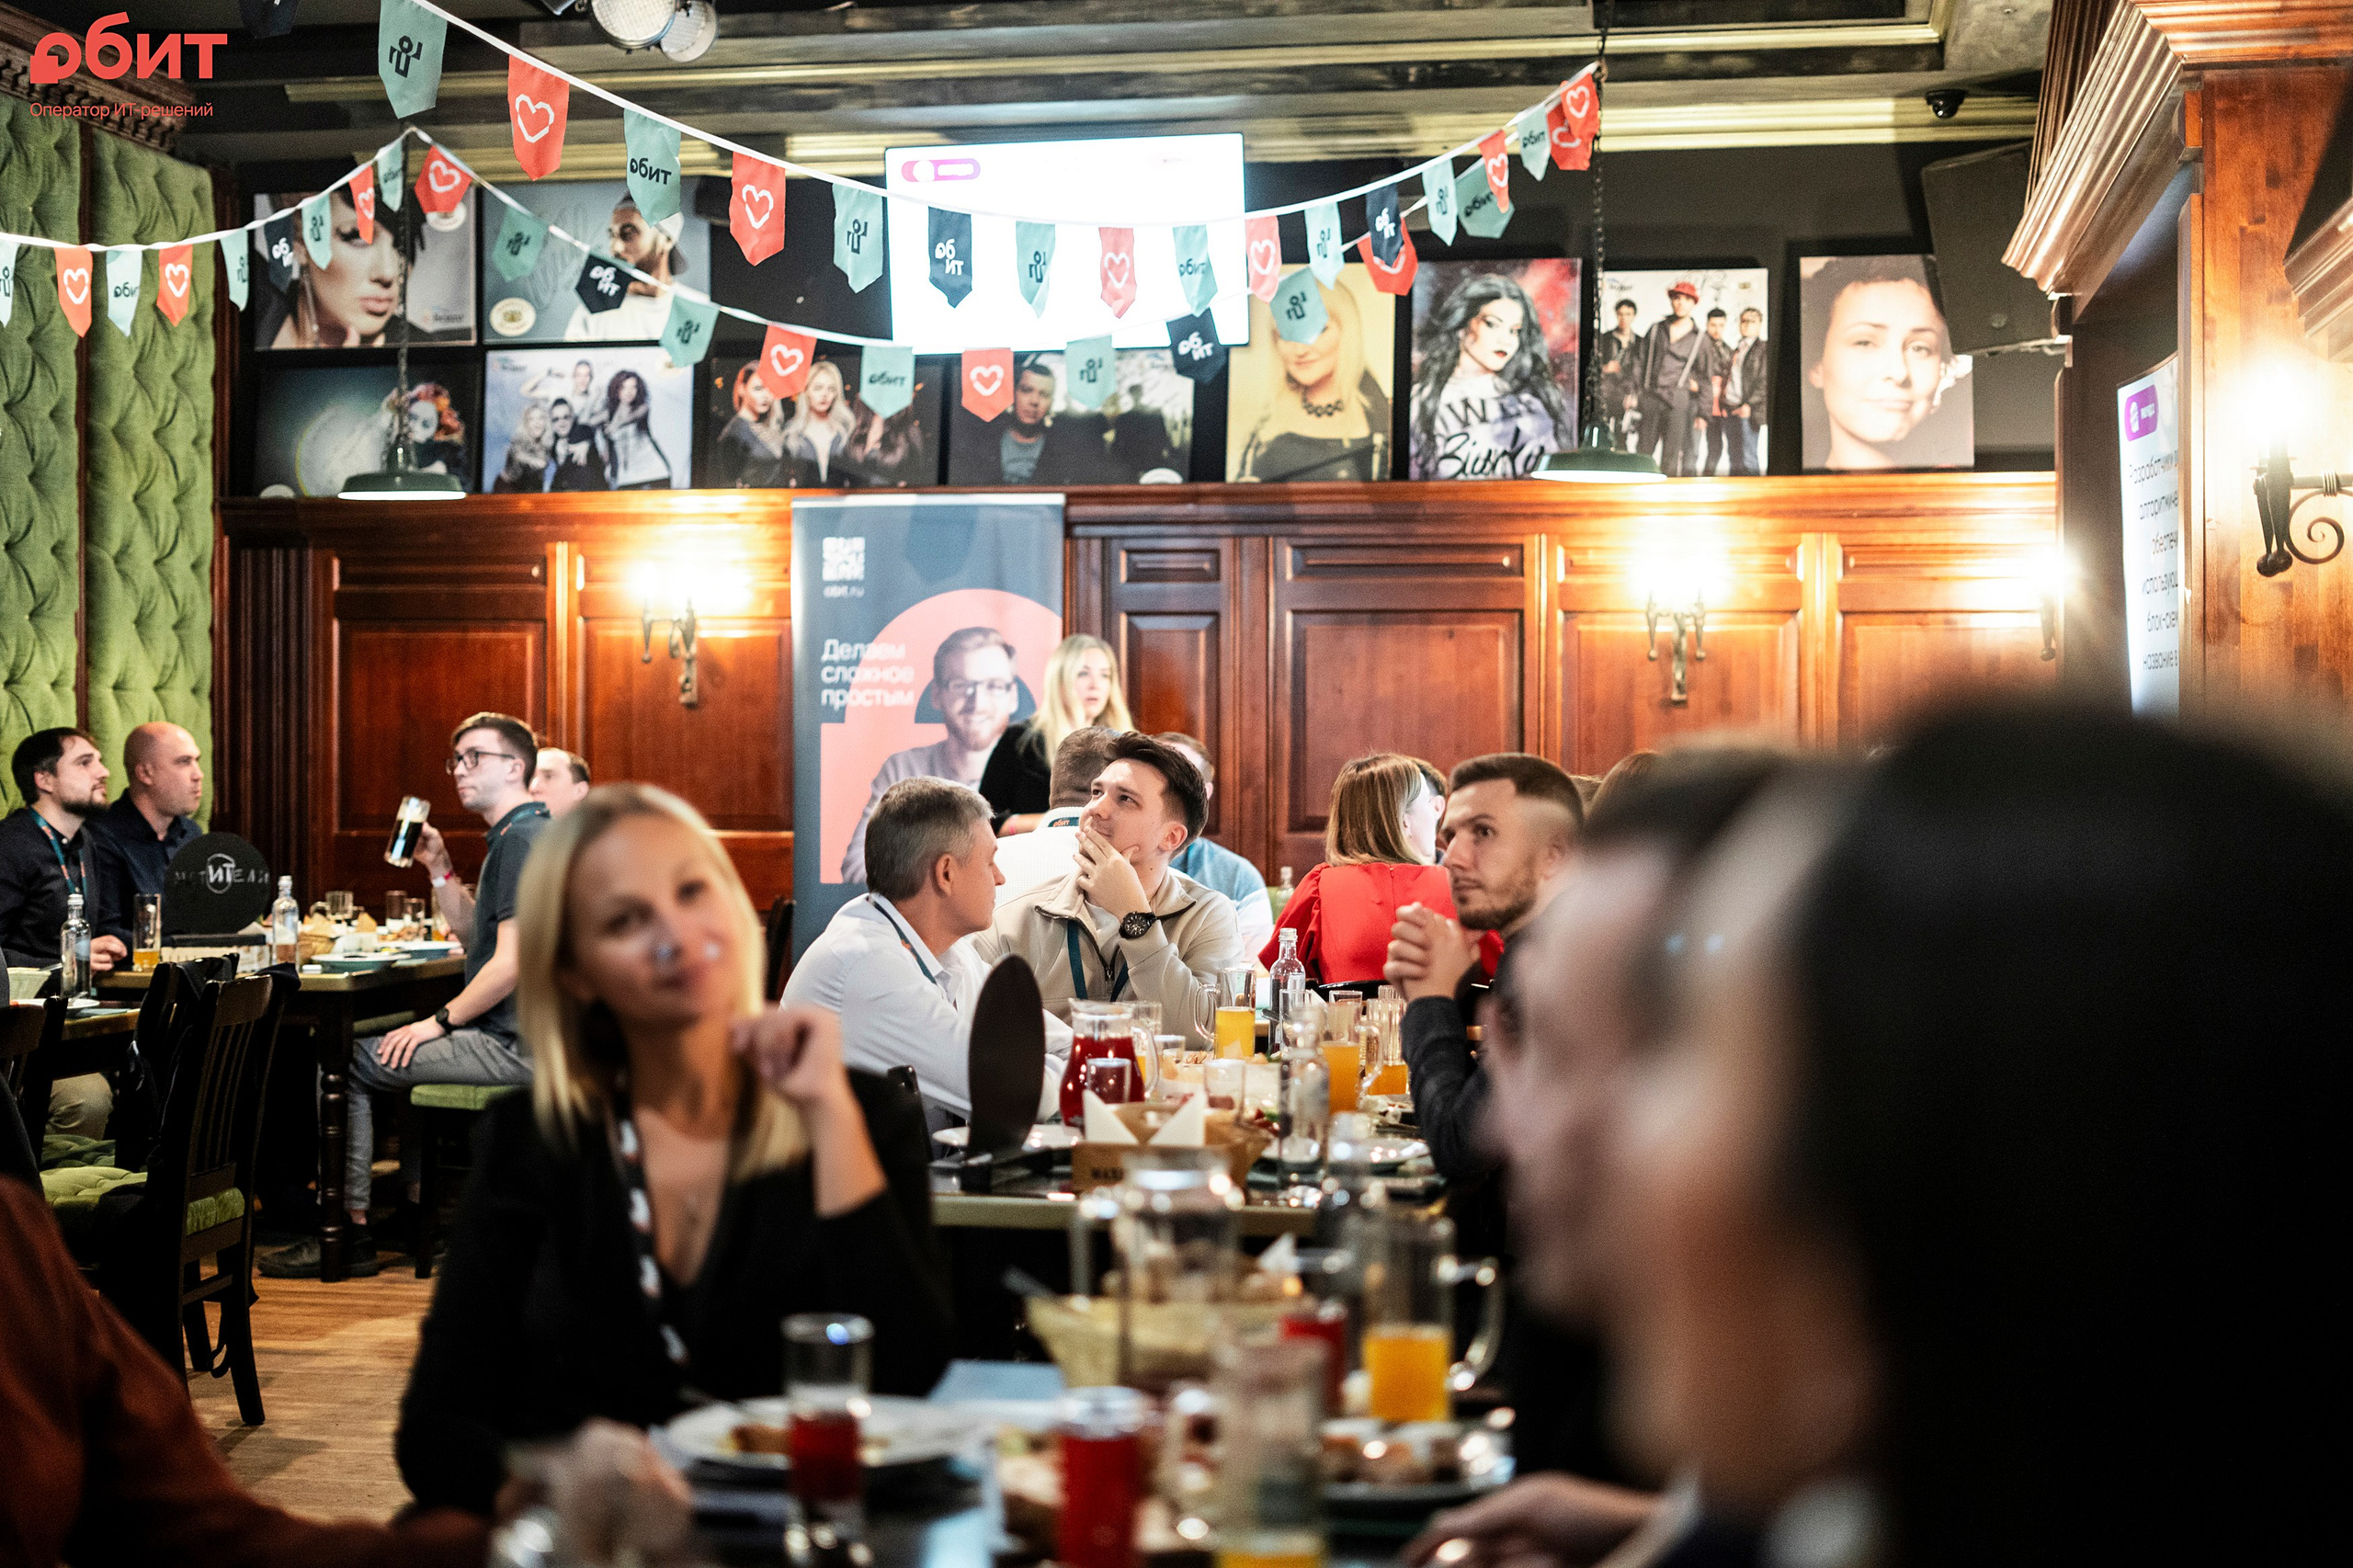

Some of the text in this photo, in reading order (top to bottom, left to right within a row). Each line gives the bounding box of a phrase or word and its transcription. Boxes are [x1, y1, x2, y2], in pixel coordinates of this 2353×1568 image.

[630, 157, 672, 185] обит
[935, 238, 956, 259] об
[945, 259, 964, 276] ит
[1178, 331, 1203, 355] об
[821, 639, 906, 663] Делаем
[821, 665, 915, 684] сложное
[821, 688, 915, 710] простым
